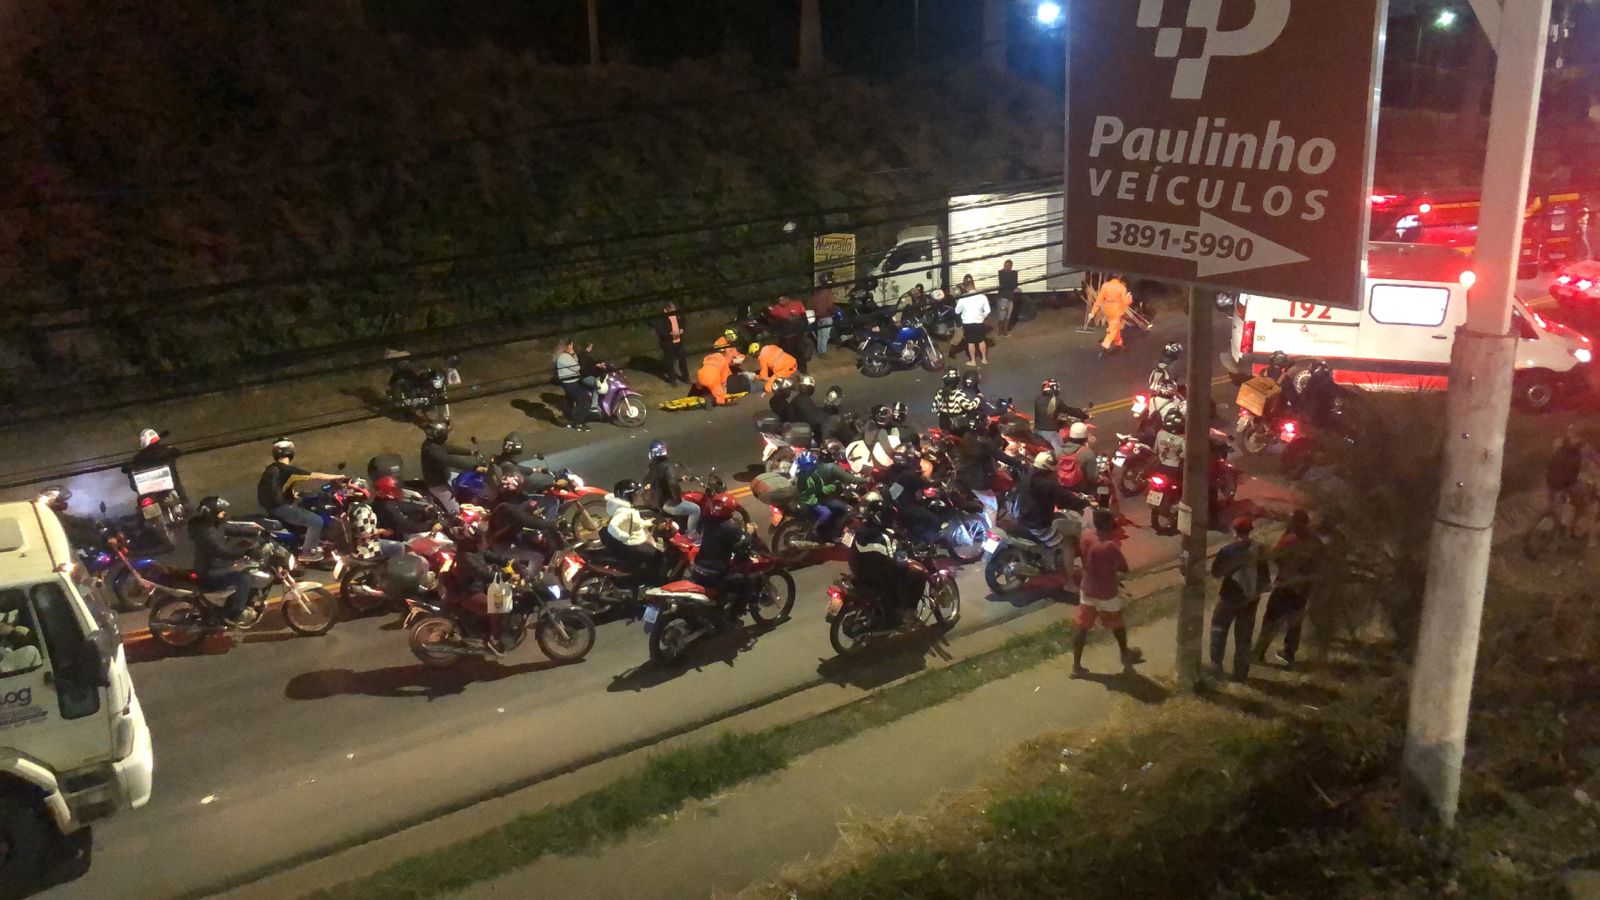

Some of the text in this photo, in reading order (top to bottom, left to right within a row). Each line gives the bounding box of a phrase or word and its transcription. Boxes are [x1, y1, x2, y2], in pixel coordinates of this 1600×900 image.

[1089, 115, 1336, 175] Paulinho
[1089, 166, 1329, 221] VEÍCULOS
[1106, 221, 1254, 262] 3891-5990
[1289, 300, 1332, 319] 192
